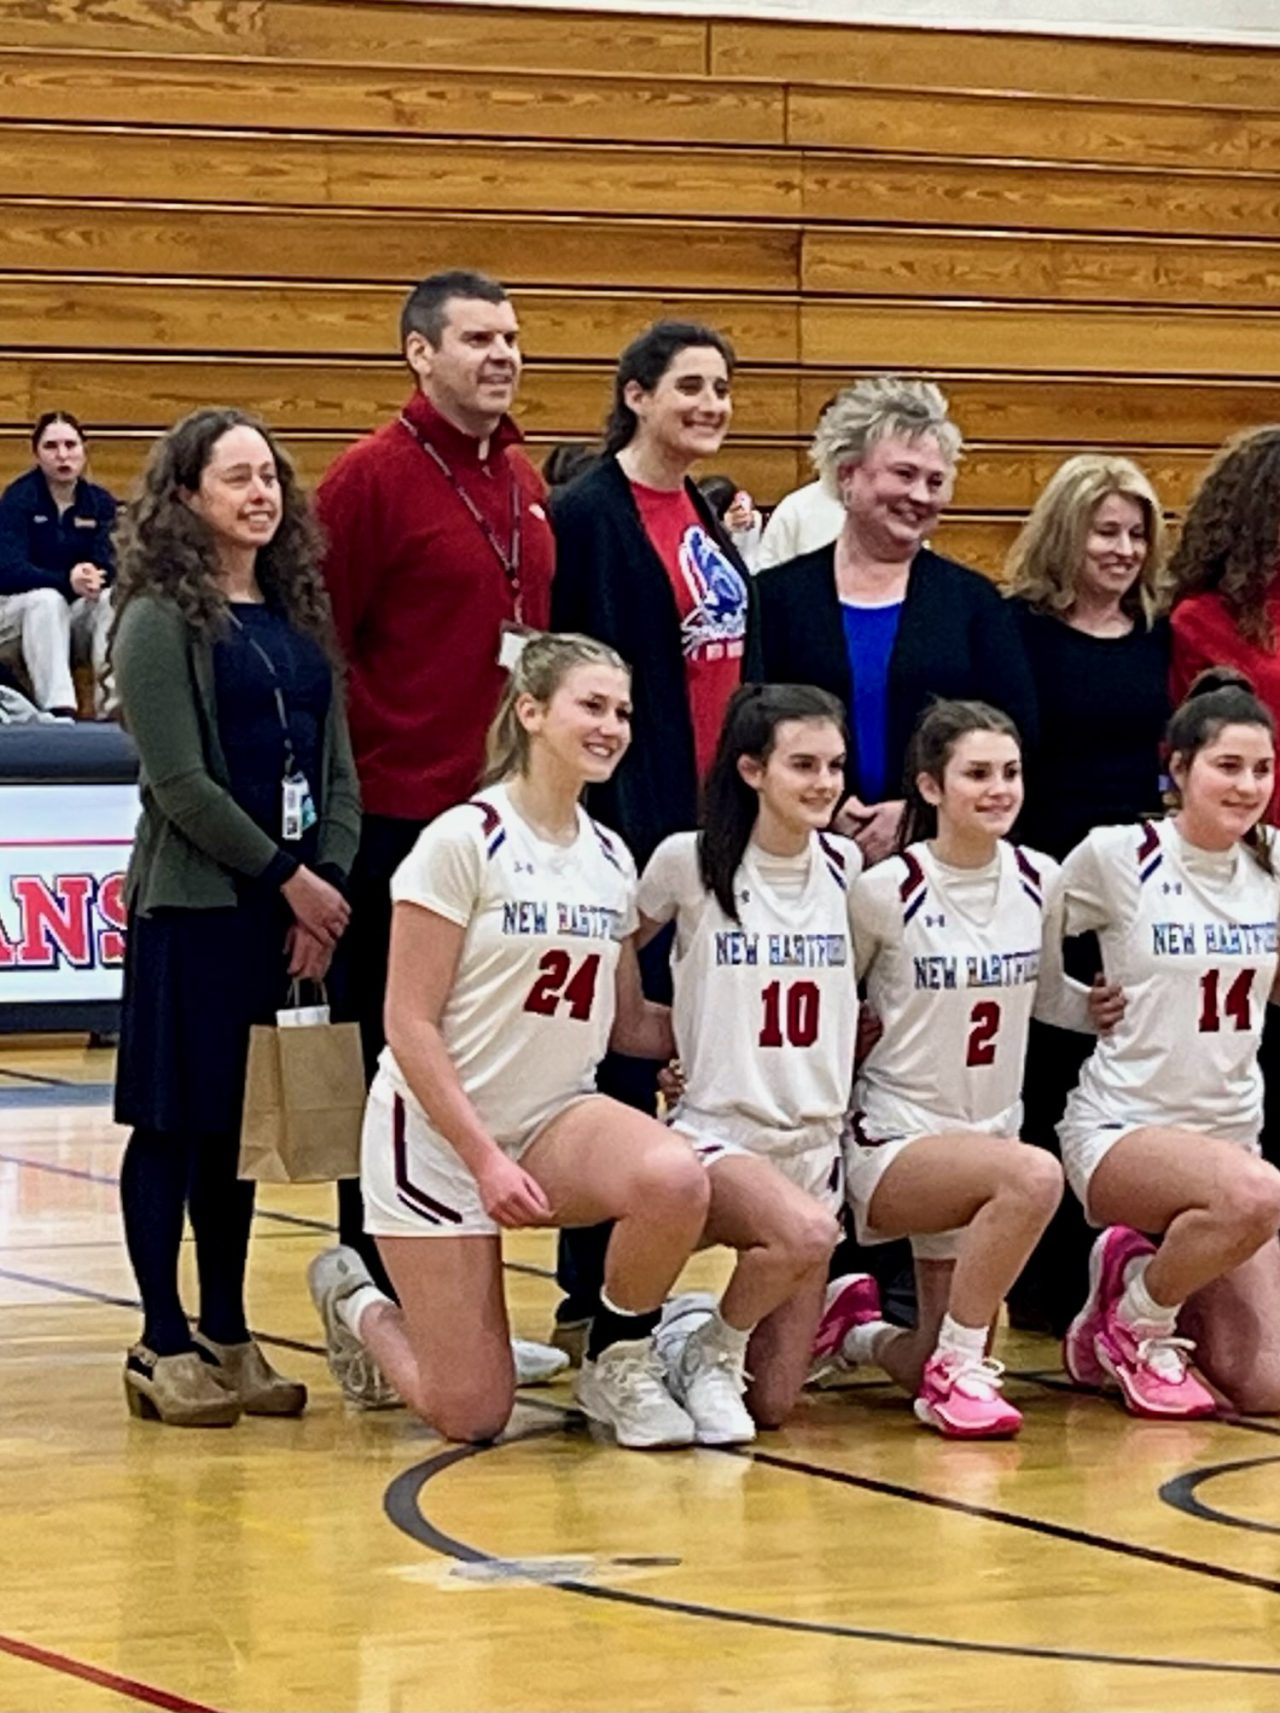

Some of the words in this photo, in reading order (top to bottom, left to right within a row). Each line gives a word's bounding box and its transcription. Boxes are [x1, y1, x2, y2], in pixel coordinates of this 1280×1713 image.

[501, 900, 547, 935] NEW
[1152, 923, 1195, 955] NEW
[715, 932, 759, 967] NEW
[914, 955, 957, 989] NEW
[523, 949, 600, 1021] 24
[1199, 968, 1256, 1032] 14
[759, 980, 820, 1047] 10
[966, 1001, 1000, 1067] 2
